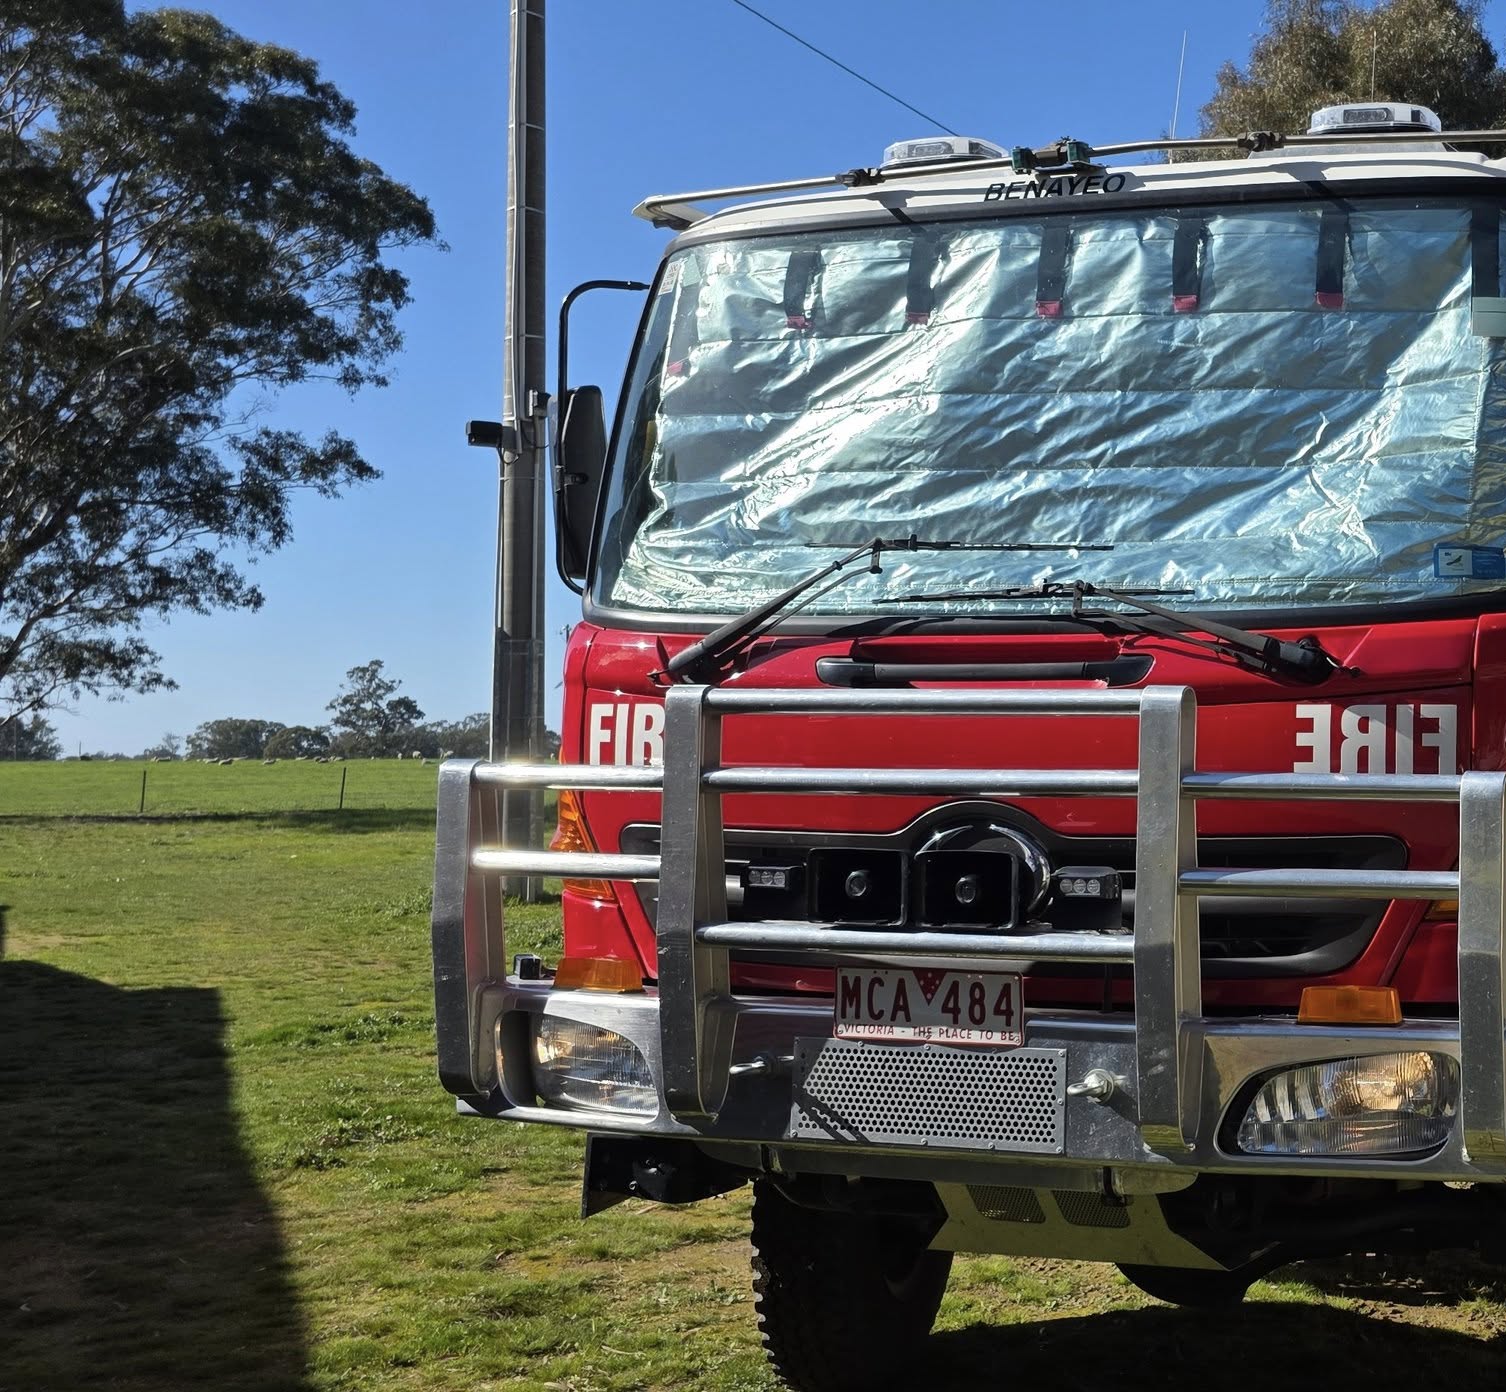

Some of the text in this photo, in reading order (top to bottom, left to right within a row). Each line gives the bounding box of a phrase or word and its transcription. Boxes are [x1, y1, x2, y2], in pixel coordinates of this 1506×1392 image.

[984, 173, 1126, 201] BENAYEO
[590, 703, 665, 766] FIR
[840, 975, 1014, 1027] MCA 484
[843, 1024, 894, 1036] VICTORIA
[912, 1026, 932, 1037] THE
[939, 1029, 972, 1040] PLACE
[980, 1030, 993, 1041] TO
[1000, 1031, 1014, 1042] BE
